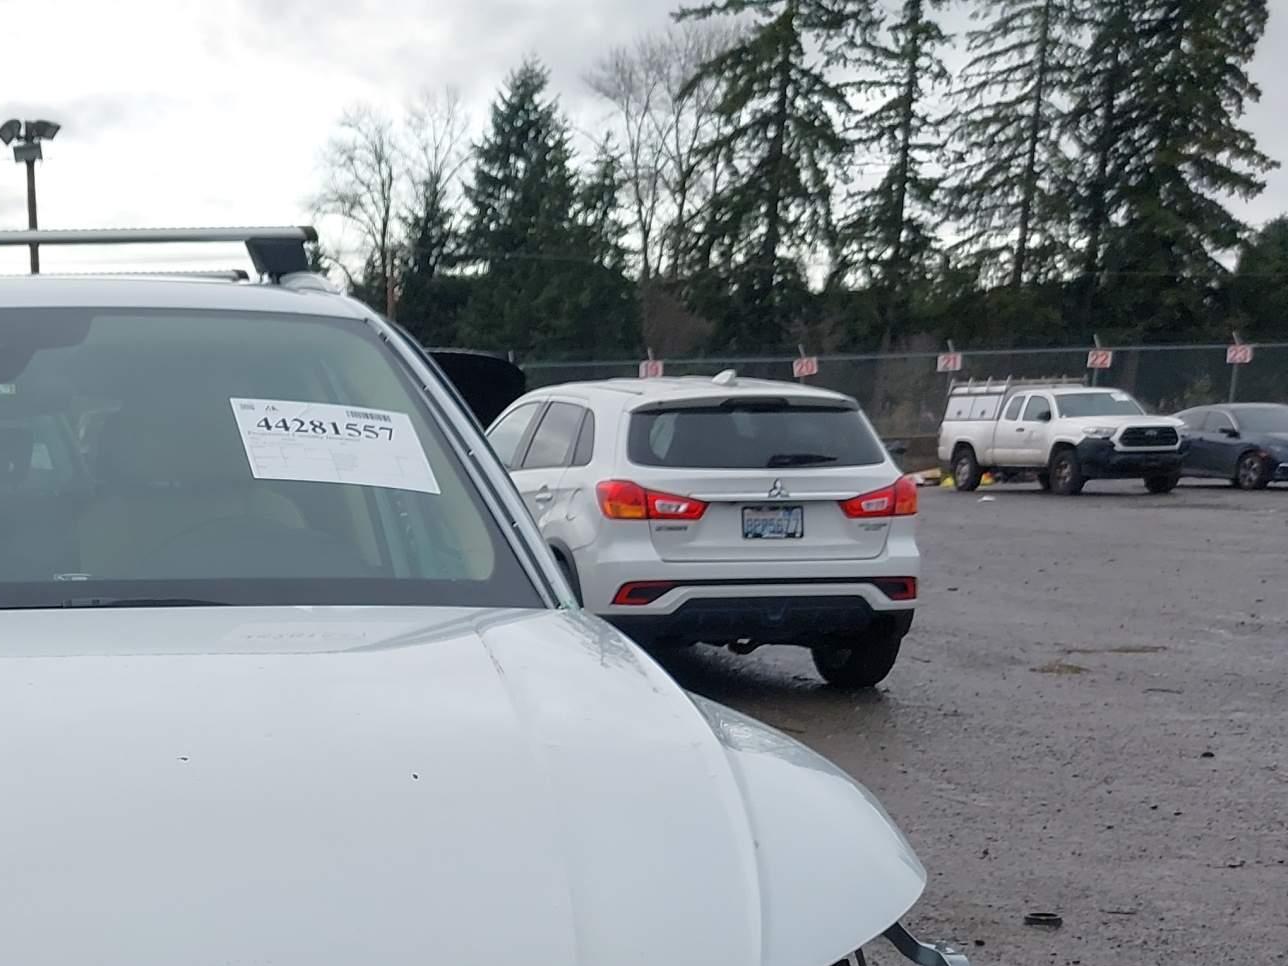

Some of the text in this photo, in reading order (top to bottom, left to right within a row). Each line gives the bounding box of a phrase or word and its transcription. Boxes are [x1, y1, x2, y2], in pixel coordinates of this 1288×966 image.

[942, 356, 958, 370] 21
[1092, 352, 1109, 367] 22
[797, 360, 814, 374] 20
[256, 416, 393, 441] 44281557
